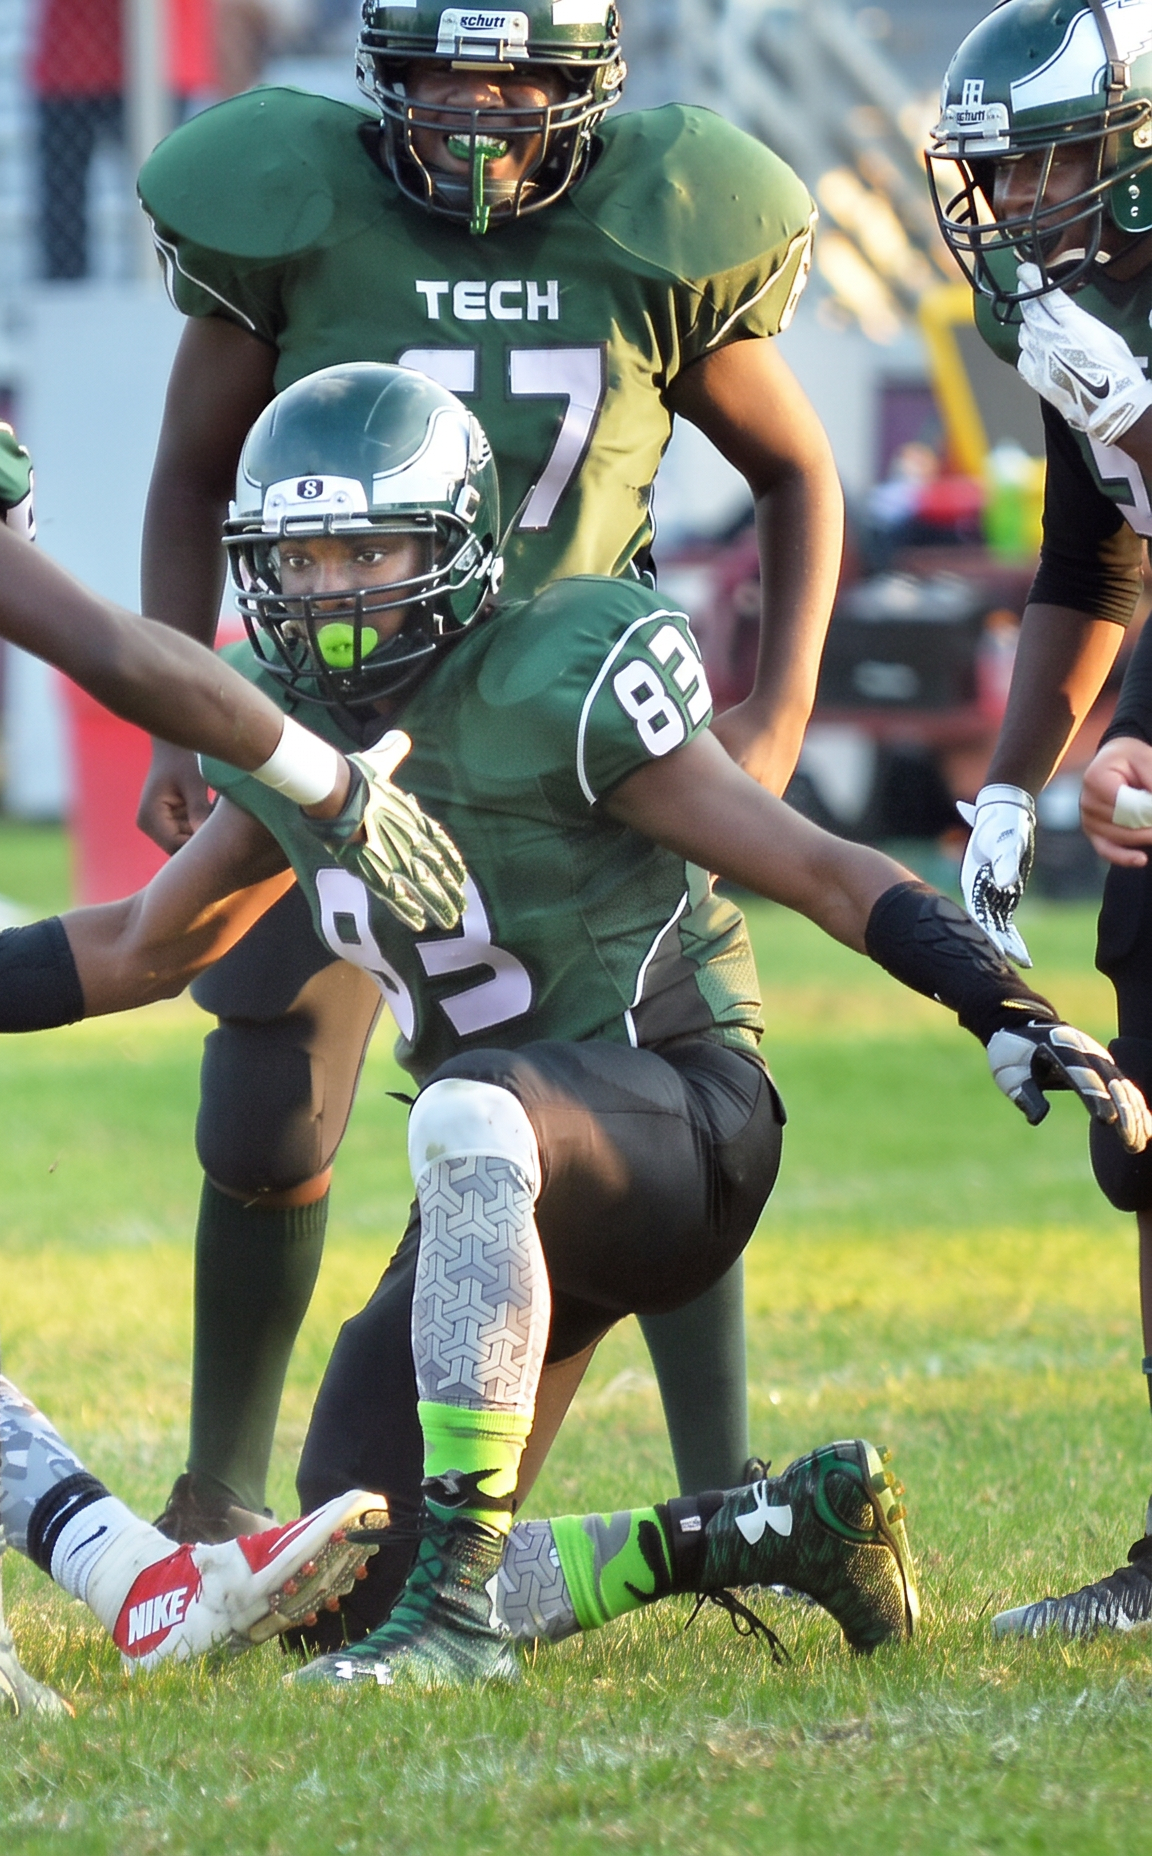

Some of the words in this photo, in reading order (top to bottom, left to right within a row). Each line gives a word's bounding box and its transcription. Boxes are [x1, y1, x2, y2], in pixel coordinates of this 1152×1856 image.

[460, 14, 505, 28] schutt
[415, 279, 559, 321] TECH
[398, 347, 602, 528] 7
[613, 624, 713, 756] 83
[128, 1587, 188, 1646] NIKE
